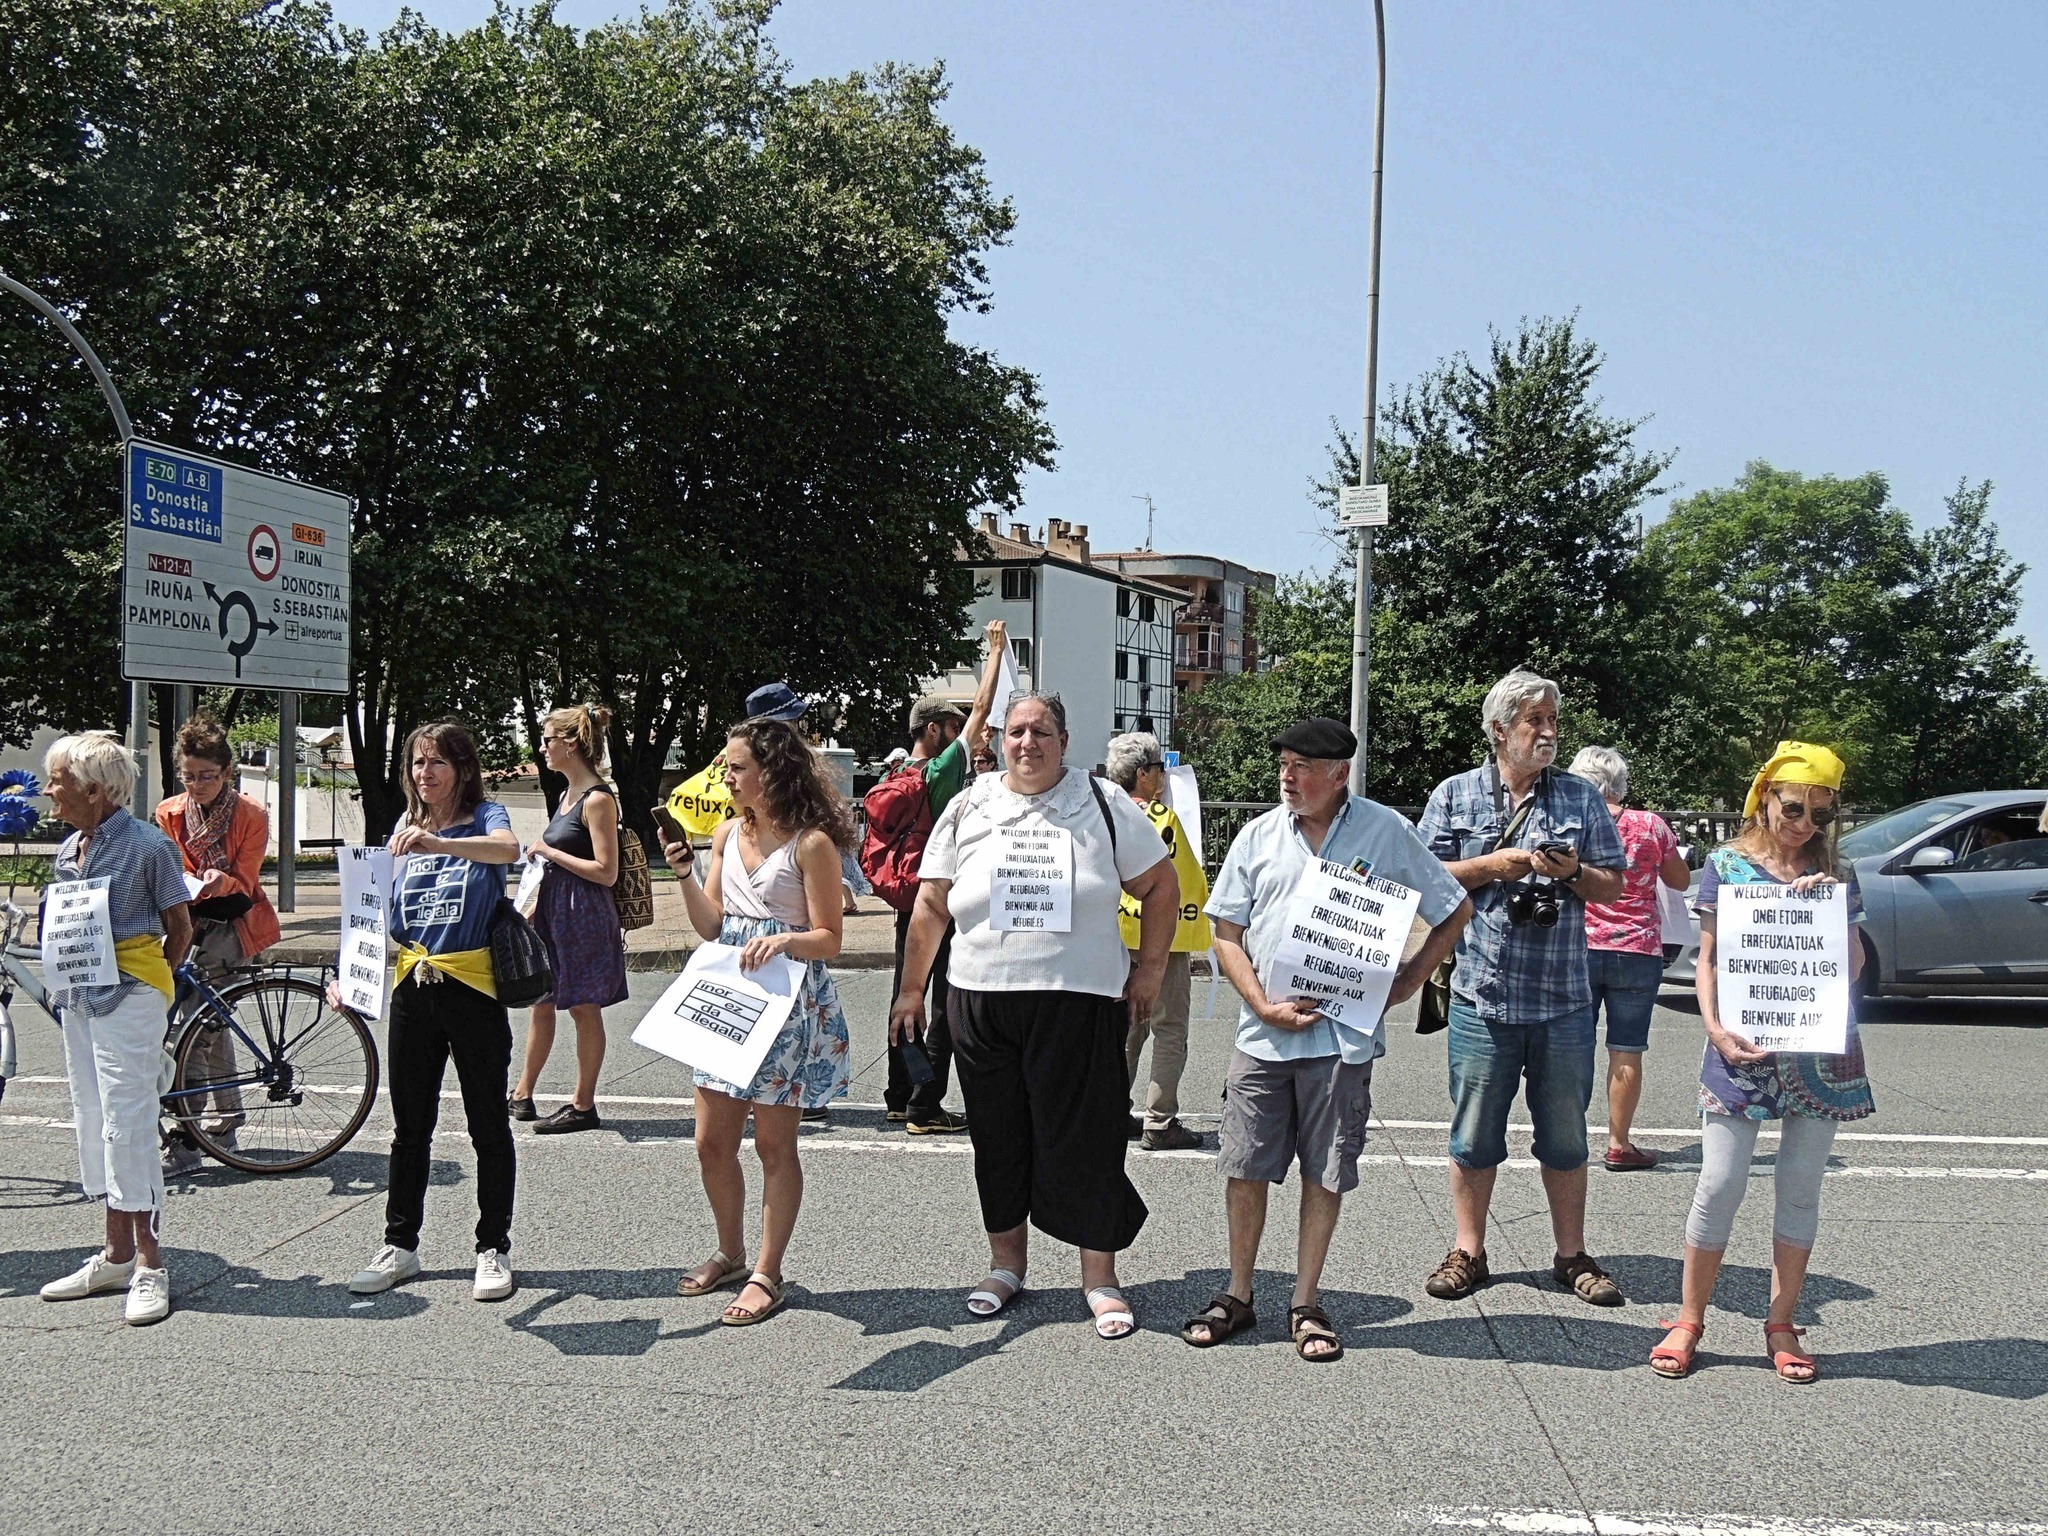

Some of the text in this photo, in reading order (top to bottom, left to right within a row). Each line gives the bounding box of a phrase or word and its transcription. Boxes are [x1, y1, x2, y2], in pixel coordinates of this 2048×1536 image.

[147, 461, 206, 488] E-70 A-8
[146, 483, 209, 513] Donostia
[132, 503, 221, 537] S. Sebastián
[295, 527, 323, 543] GI-636
[149, 555, 191, 575] N-121-A
[294, 549, 322, 567] IRUN
[145, 579, 194, 602] IRUÑA
[281, 576, 341, 601] DONOSTIA
[129, 605, 211, 632] PAMPLONA
[301, 626, 343, 641] aireportua
[1000, 828, 1061, 839] WELCOME REFUGEES
[1012, 841, 1049, 850] ONGI ETORRI
[411, 860, 439, 873] inor
[1005, 854, 1055, 864] ERREFUXIATUAK
[435, 873, 450, 885] ez
[997, 868, 1063, 879] BIENVENID@S A L@S
[1009, 884, 1050, 895] REFUGIAD@S
[1365, 875, 1409, 900] REFUGEES
[1734, 886, 1782, 899] WELCOME
[419, 891, 439, 903] da
[1004, 900, 1054, 911] BIENVENUE AUX
[1329, 887, 1384, 917] ONGI ETORRI
[1310, 905, 1387, 940] ERREFUXIATUAK
[1753, 909, 1813, 925] ONGI ETORRI
[83, 927, 89, 936] A
[90, 925, 104, 936] L@S
[1292, 924, 1390, 968] BIENVENID@S A L@S
[1741, 934, 1824, 951] ERREFUXIATUAK
[56, 957, 102, 972] BIENVENUE AUX
[1303, 954, 1364, 984] REFUGIAD@S
[1728, 958, 1837, 977] BIENVENID@S A L@S
[700, 981, 733, 997] inor
[1290, 974, 1365, 1002] BIENVENUE AUX
[1749, 984, 1816, 1002] REFUGIAD@S
[700, 1004, 721, 1018] da
[724, 1002, 744, 1014] ez
[691, 1010, 743, 1042] ilegala
[1742, 1009, 1823, 1027] BIENVENUE AUX
